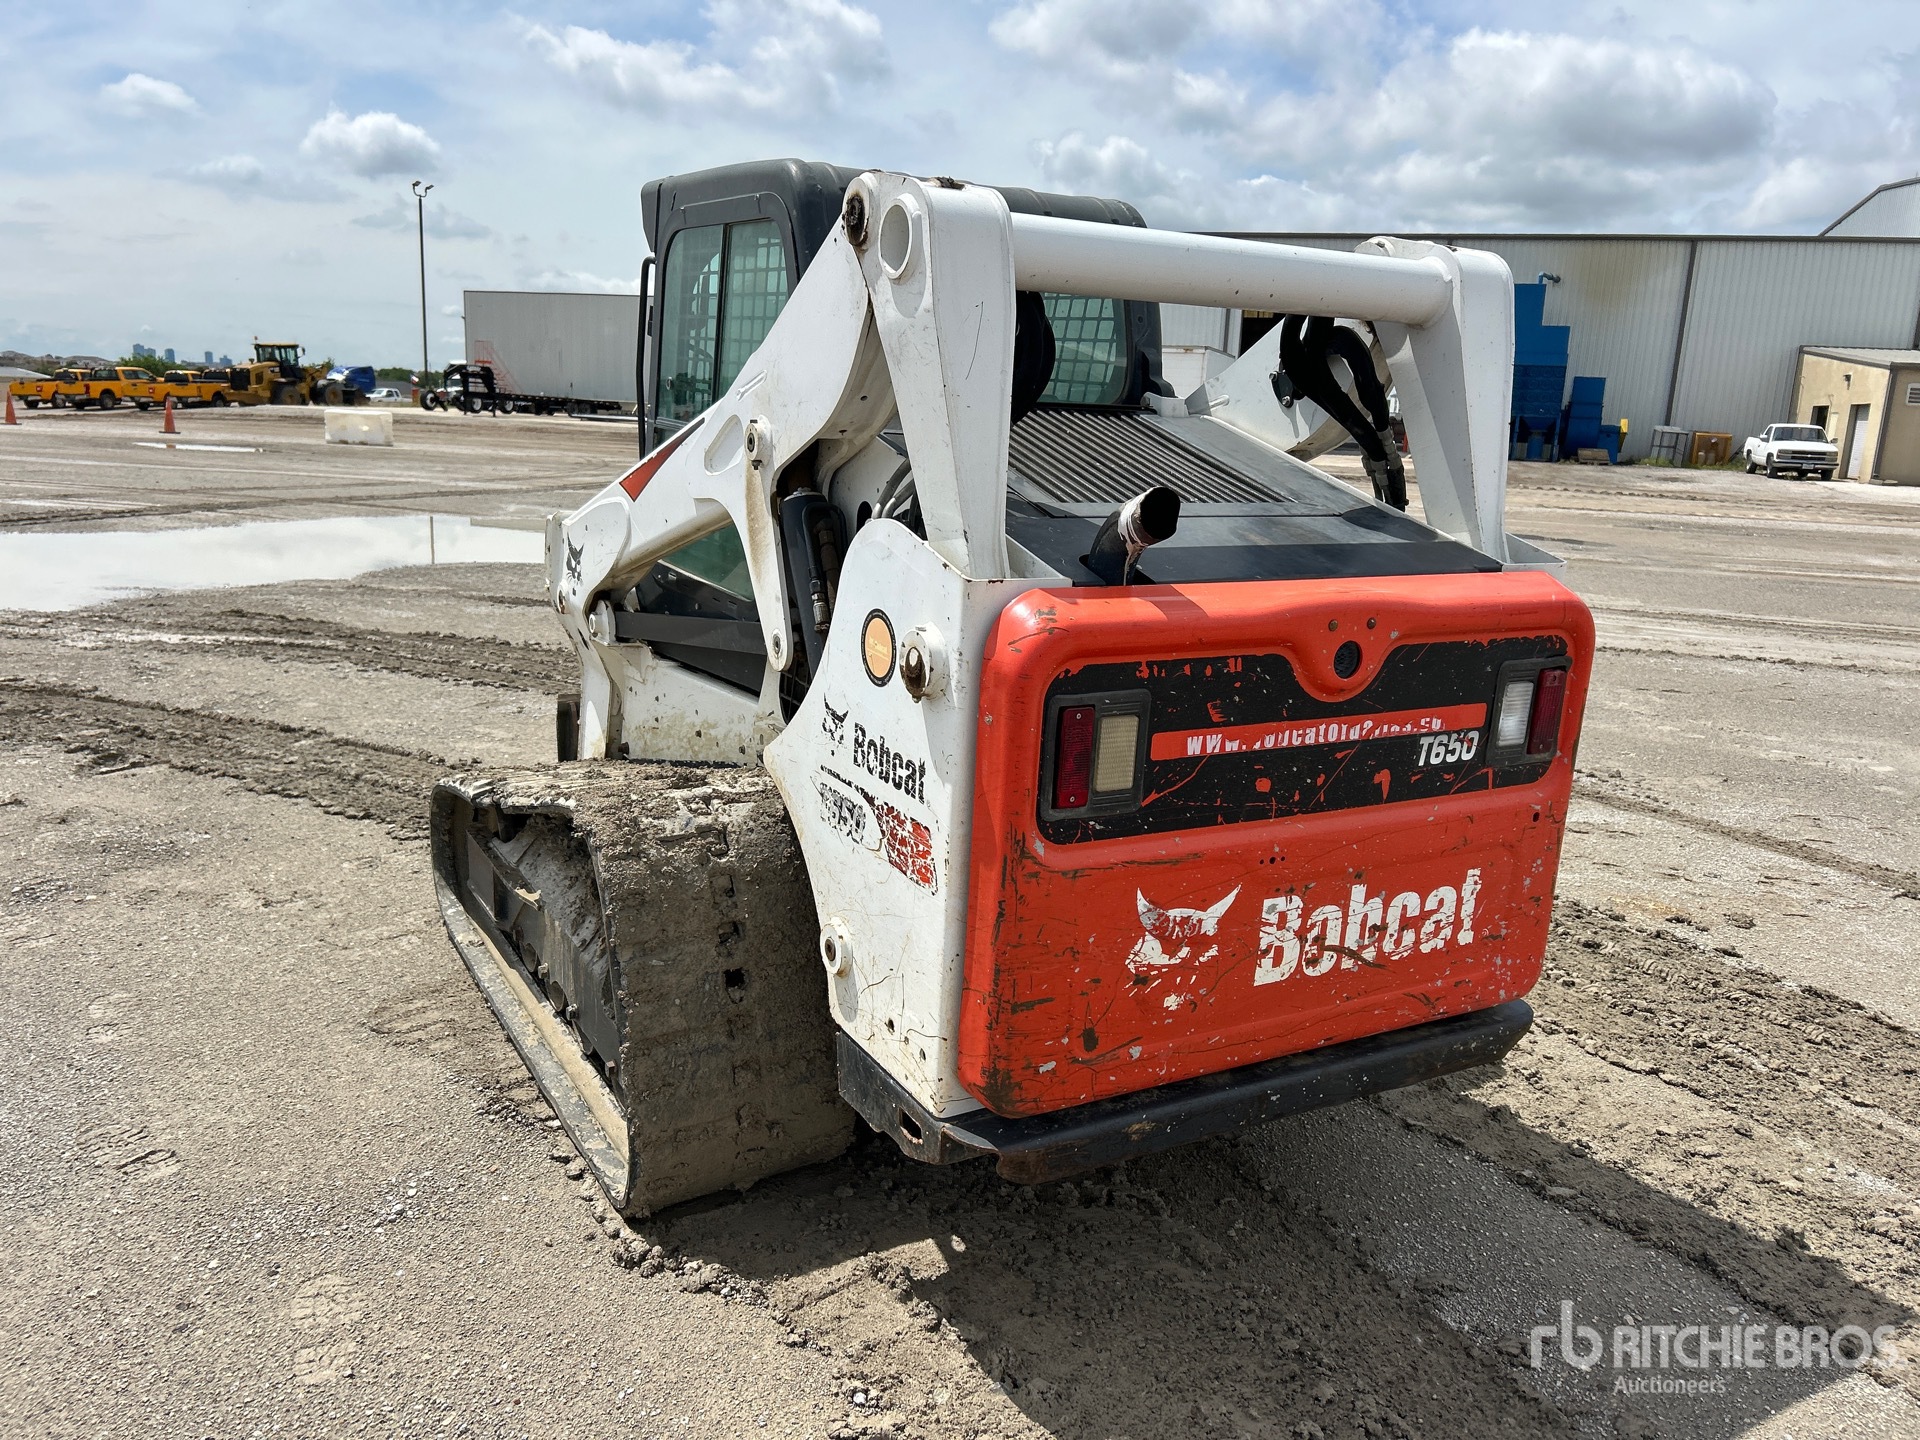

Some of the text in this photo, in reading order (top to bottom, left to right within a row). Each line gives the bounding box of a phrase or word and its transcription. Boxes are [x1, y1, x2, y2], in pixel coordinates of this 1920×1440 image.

[853, 721, 926, 804] Bobcat
[1418, 731, 1479, 767] T650
[1253, 868, 1482, 987] Bobcat
